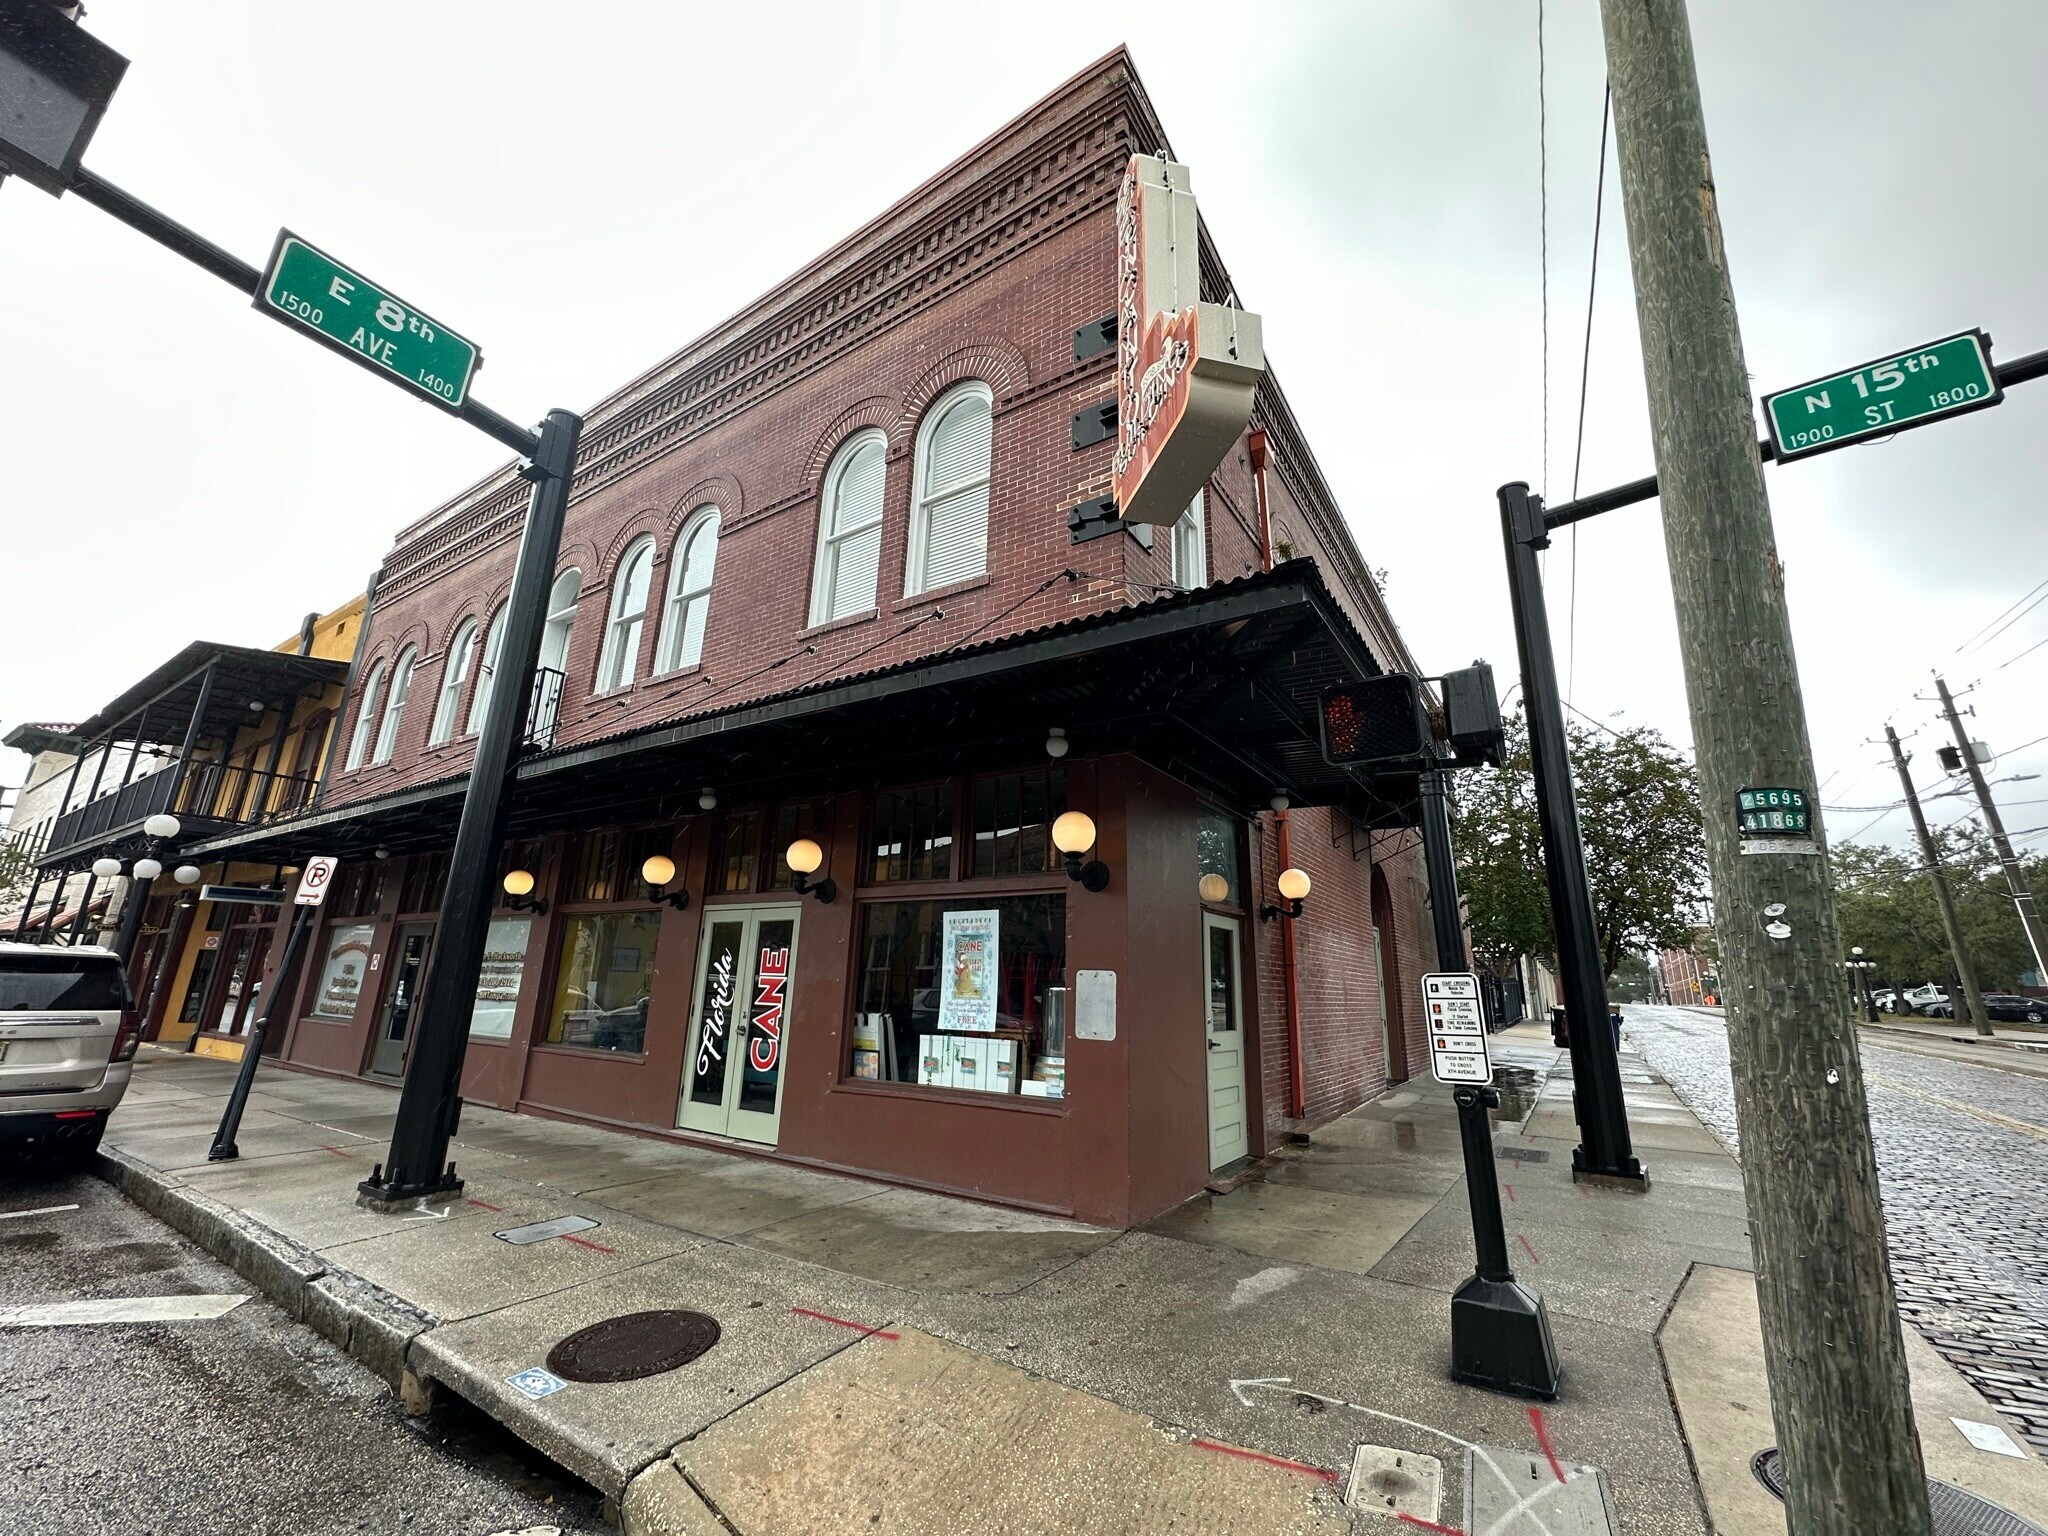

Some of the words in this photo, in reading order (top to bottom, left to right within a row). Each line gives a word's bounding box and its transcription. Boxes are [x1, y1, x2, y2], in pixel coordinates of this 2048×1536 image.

[280, 291, 323, 324] 1500
[329, 276, 355, 306] E
[375, 300, 436, 343] 8th
[349, 327, 398, 366] AVE
[418, 368, 454, 398] 1400
[1804, 390, 1831, 414] N
[1851, 354, 1940, 398] 15th
[1929, 382, 1979, 408] 1800
[1864, 400, 1895, 426] ST
[1790, 424, 1834, 448] 1900
[1742, 792, 1802, 806] 25695
[1746, 813, 1805, 829] 41868
[957, 941, 983, 951] CANE
[697, 947, 734, 1075] Florida
[750, 947, 789, 1072] CANE
[957, 1015, 977, 1024] FREE
